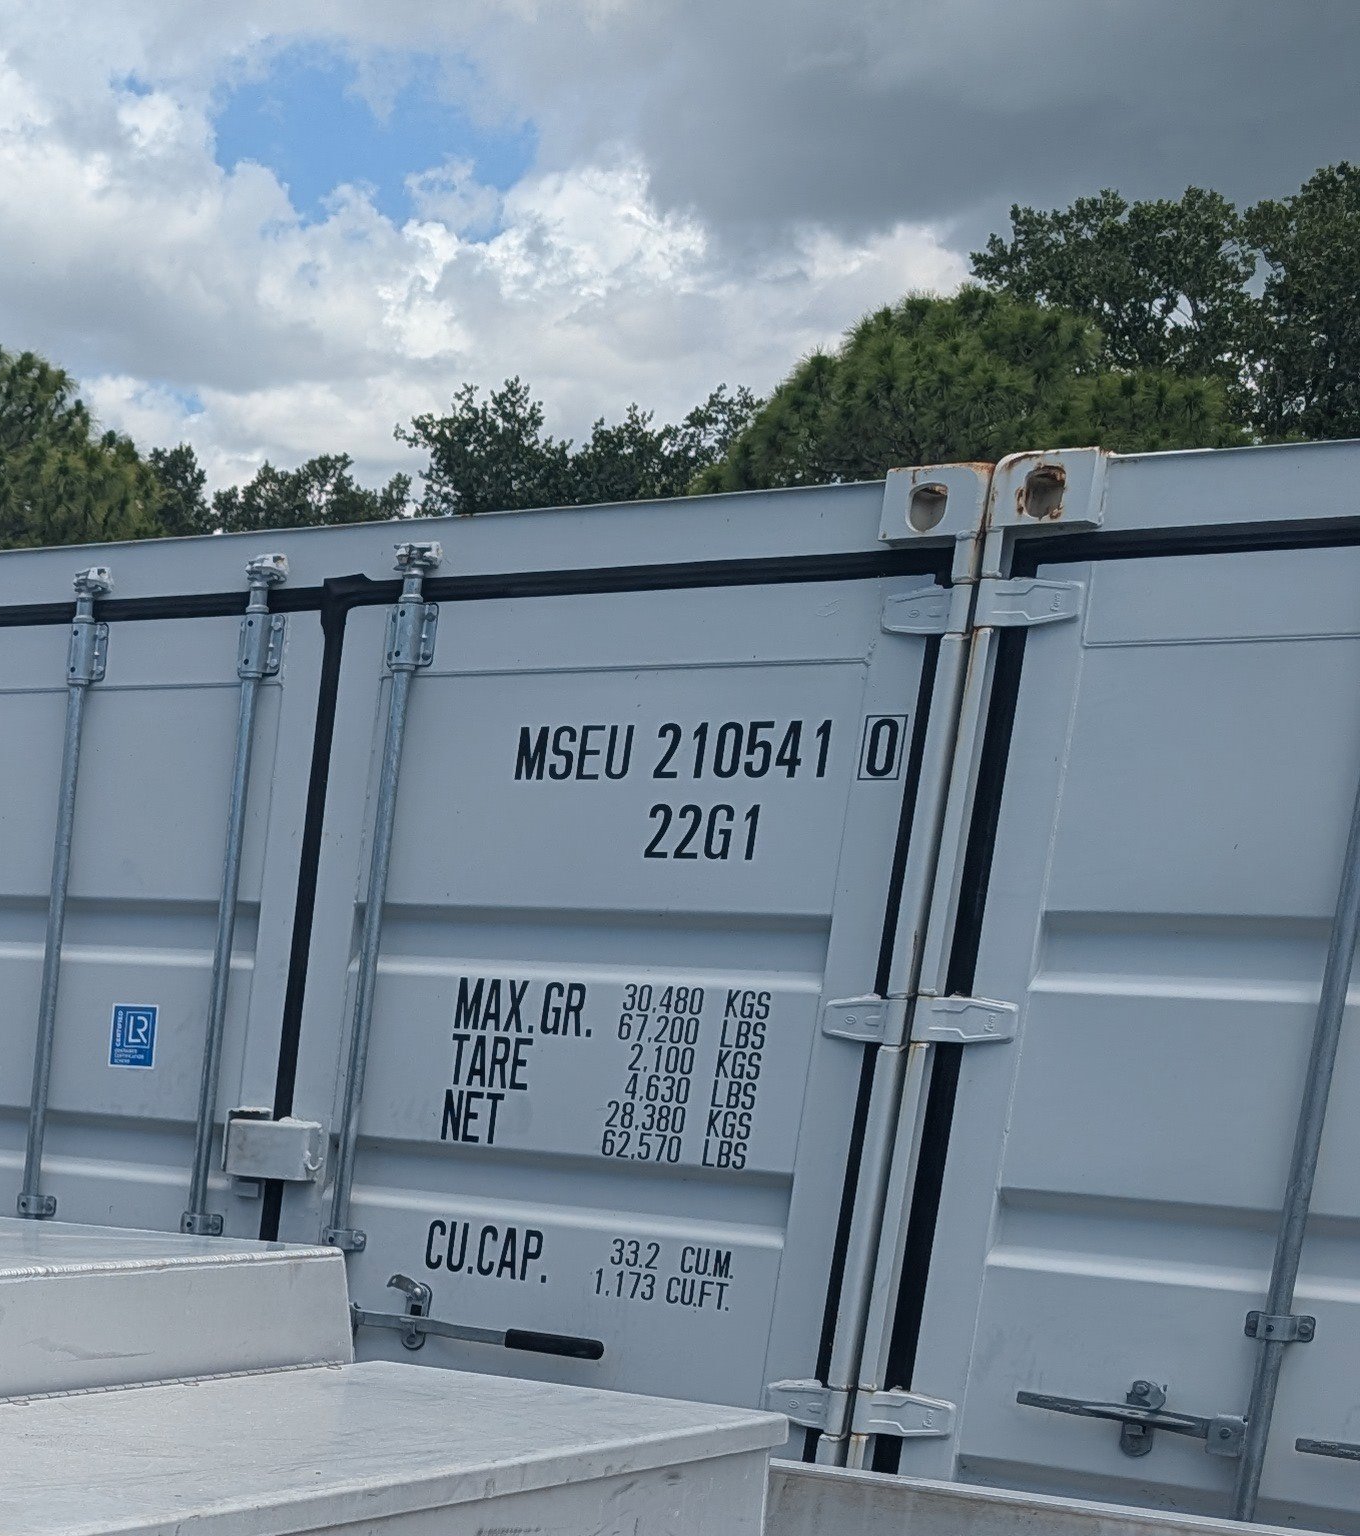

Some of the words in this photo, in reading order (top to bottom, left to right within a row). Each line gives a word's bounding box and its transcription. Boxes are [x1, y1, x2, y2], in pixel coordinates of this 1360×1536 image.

[514, 724, 635, 780] MSEU
[652, 719, 833, 779] 210541
[865, 718, 900, 777] 0
[643, 803, 761, 860] 22G1
[128, 1015, 148, 1044] LR
[454, 977, 593, 1038] MAX.GR.
[622, 984, 705, 1016] 30,480
[724, 989, 772, 1020] KGS
[617, 1013, 701, 1045] 67,200
[719, 1019, 767, 1050] LBS
[452, 1033, 534, 1091] TARE
[627, 1043, 695, 1075] 2,100
[714, 1049, 762, 1081] KGS
[440, 1089, 505, 1145] NET
[604, 1100, 687, 1134] 28,380
[705, 1109, 753, 1140] KGS
[625, 1073, 692, 1104] 4,630
[710, 1079, 757, 1110] LBS
[601, 1129, 683, 1163] 62,570
[701, 1138, 748, 1170] LBS
[425, 1219, 547, 1284] CU.CAP.
[609, 1238, 661, 1271] 33.2
[680, 1245, 735, 1280] CU.M.
[595, 1267, 656, 1301] 1,173
[665, 1276, 730, 1312] CU.FT.
